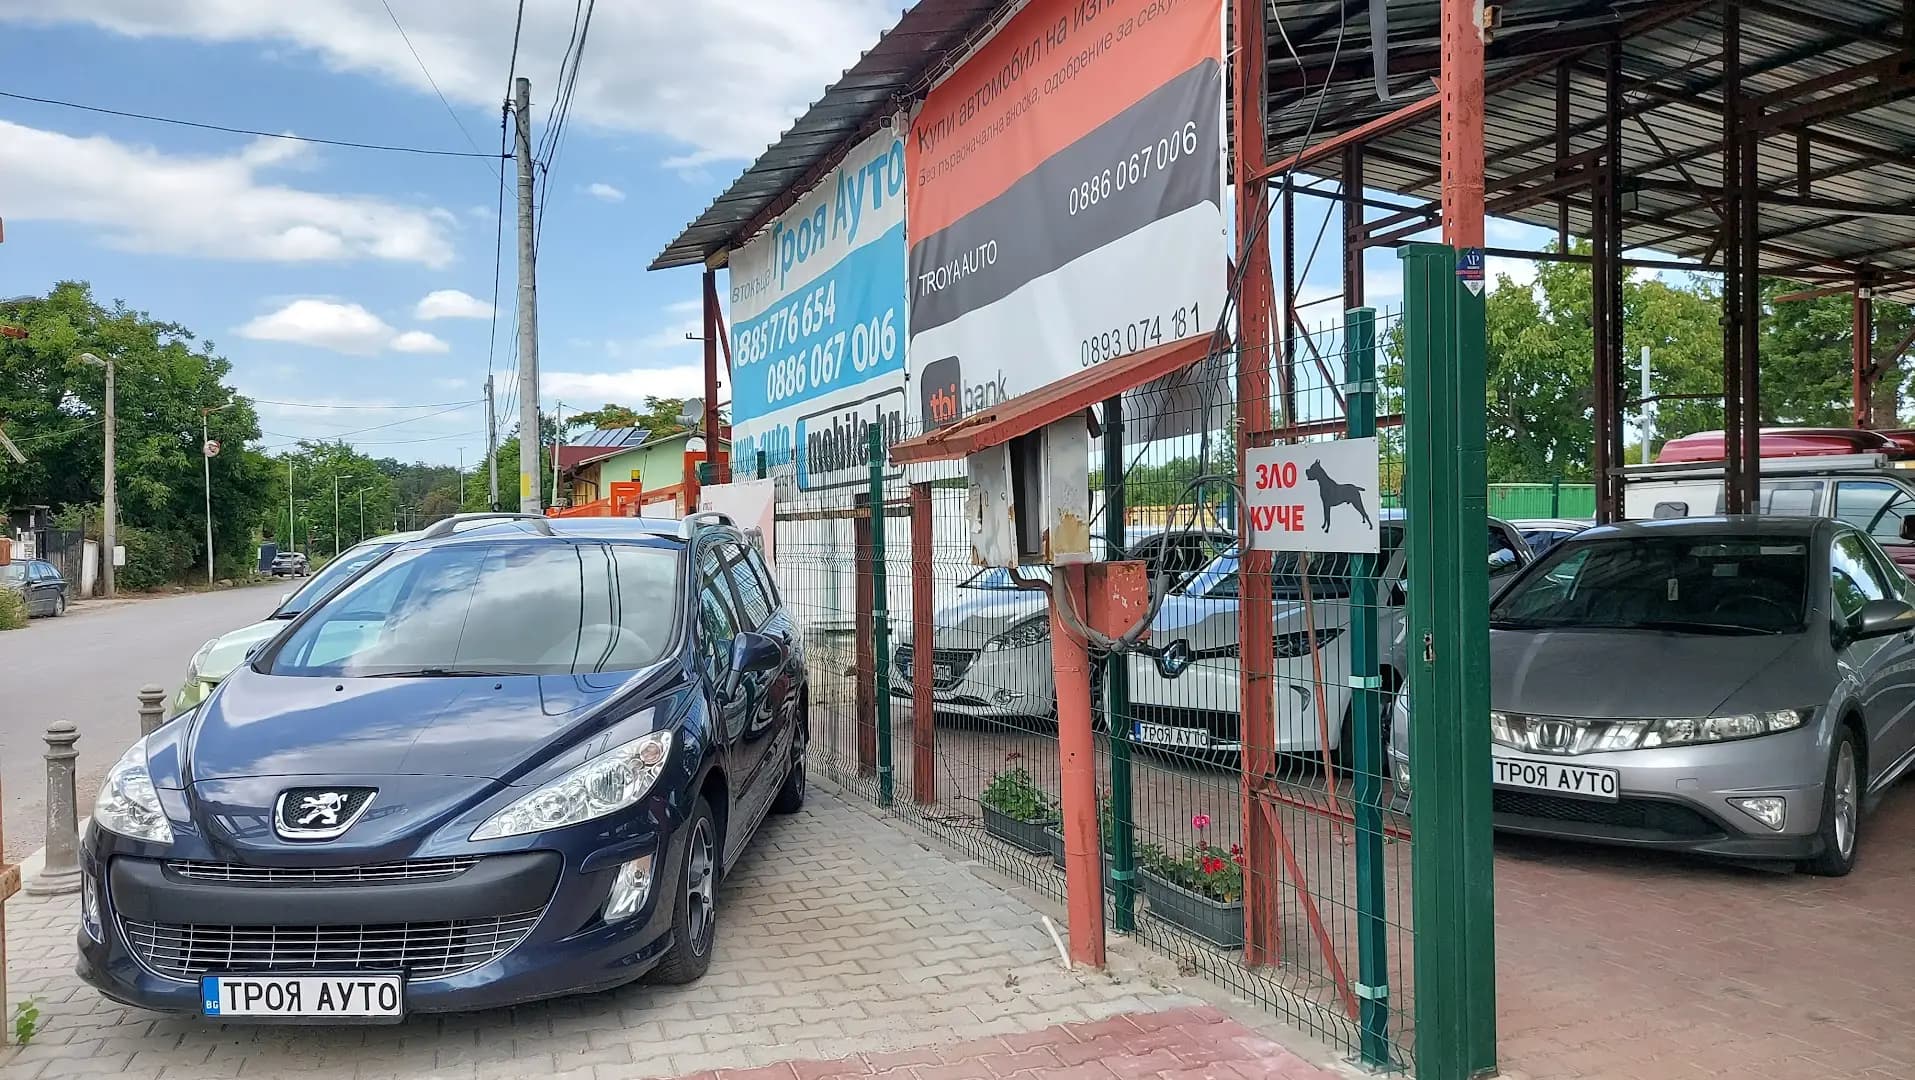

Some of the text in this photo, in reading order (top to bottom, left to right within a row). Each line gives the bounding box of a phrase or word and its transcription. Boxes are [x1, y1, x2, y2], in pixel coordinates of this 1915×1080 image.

[917, 111, 955, 155] Купи
[959, 36, 1041, 127] автомобил
[1046, 15, 1067, 56] на
[919, 165, 936, 187] Без
[1044, 31, 1113, 95] одобрение
[1116, 17, 1134, 42] за
[1068, 120, 1198, 217] 0886 067 006
[772, 139, 904, 291] Троя Ауто
[801, 279, 836, 337] 654
[767, 307, 896, 404] 0886 067 006
[1081, 328, 1122, 368] 0893
[1127, 315, 1162, 353] 074
[930, 368, 1007, 422] tbi bank
[1255, 461, 1298, 490] ЗЛО
[1250, 504, 1305, 532] КУЧЕ
[1142, 725, 1207, 747] ТРОЯ АУТО
[1496, 761, 1616, 794] ТРОЯ АУТО
[205, 999, 219, 1010] BG
[223, 981, 398, 1012] ТРОЯ АУТО
